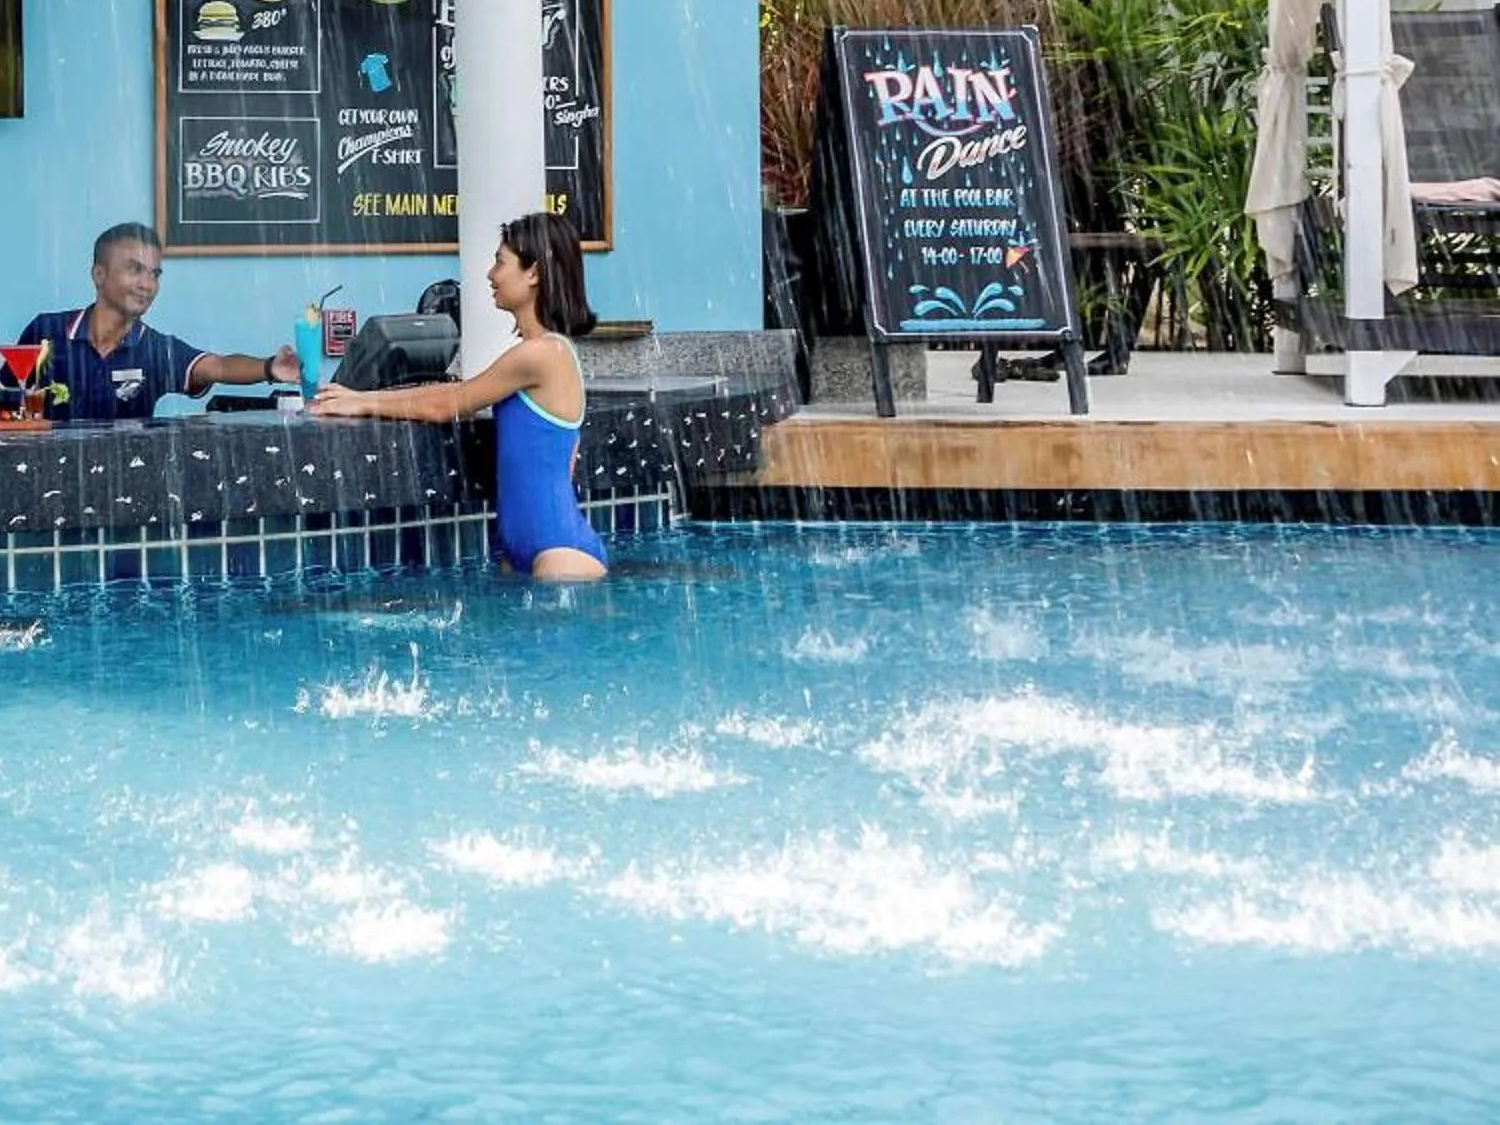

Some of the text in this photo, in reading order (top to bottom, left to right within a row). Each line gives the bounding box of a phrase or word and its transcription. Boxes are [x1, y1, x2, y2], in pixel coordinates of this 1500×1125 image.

[863, 64, 1018, 127] RAIN
[359, 108, 389, 126] YOUR
[199, 130, 298, 164] Smokey
[371, 148, 422, 165] T-SHIRT
[917, 125, 1027, 179] Dance
[183, 162, 312, 195] BBQ RIBS
[353, 193, 382, 216] SEE
[385, 193, 427, 216] MAIN
[899, 188, 918, 208] AT
[921, 188, 950, 208] THE
[986, 188, 1015, 207] BAR
[904, 218, 1017, 237] EVERY SATURDAY
